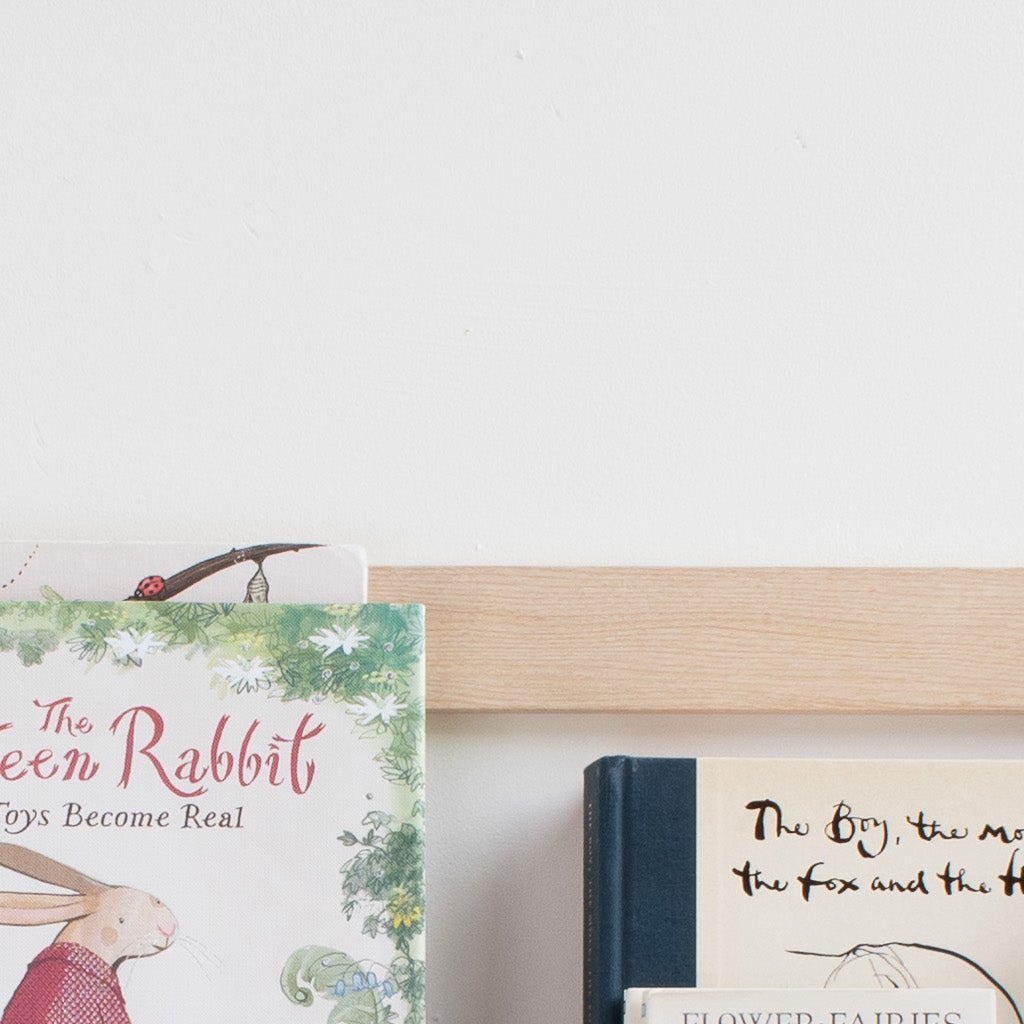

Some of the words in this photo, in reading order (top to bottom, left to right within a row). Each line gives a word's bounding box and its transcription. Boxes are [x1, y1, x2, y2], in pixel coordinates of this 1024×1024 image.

[33, 696, 94, 738] The
[0, 722, 100, 781] een
[109, 705, 327, 798] Rabbit
[62, 802, 170, 828] Become
[180, 802, 245, 829] Real
[744, 798, 810, 841] The
[824, 799, 901, 859] Boy,
[906, 810, 969, 841] the
[731, 860, 789, 897] the
[796, 861, 861, 903] fox
[870, 870, 930, 896] and
[935, 861, 992, 896] the
